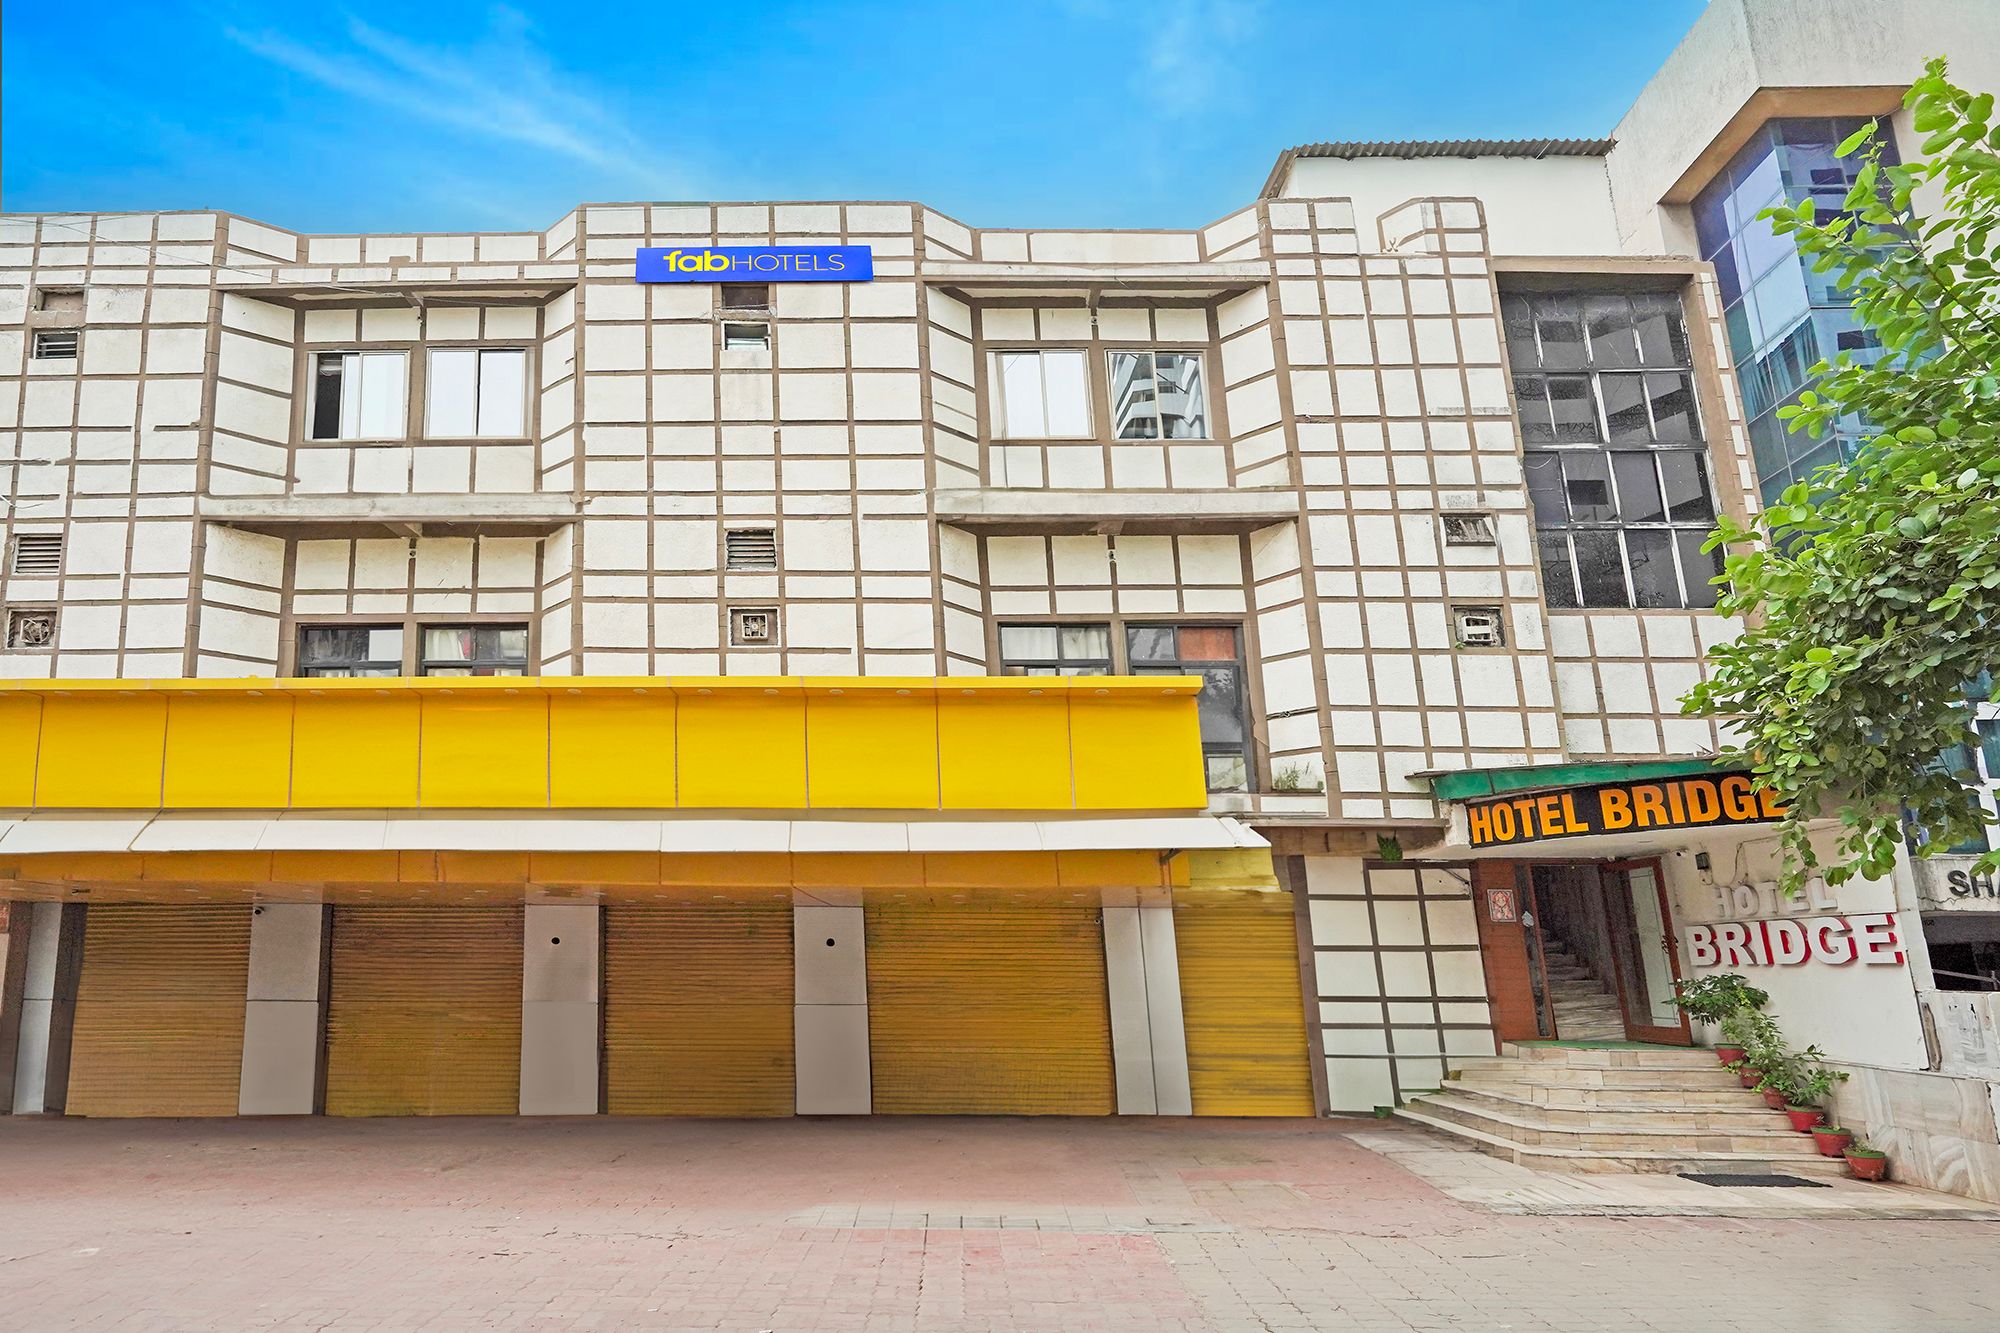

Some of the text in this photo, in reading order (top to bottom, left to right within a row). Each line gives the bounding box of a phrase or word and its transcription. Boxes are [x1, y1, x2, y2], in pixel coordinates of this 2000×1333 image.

[1469, 793, 1589, 845] HOTEL
[1709, 876, 1838, 918] HOTEL
[1948, 870, 2000, 898] SH
[1684, 914, 1904, 967] BRIDGE
